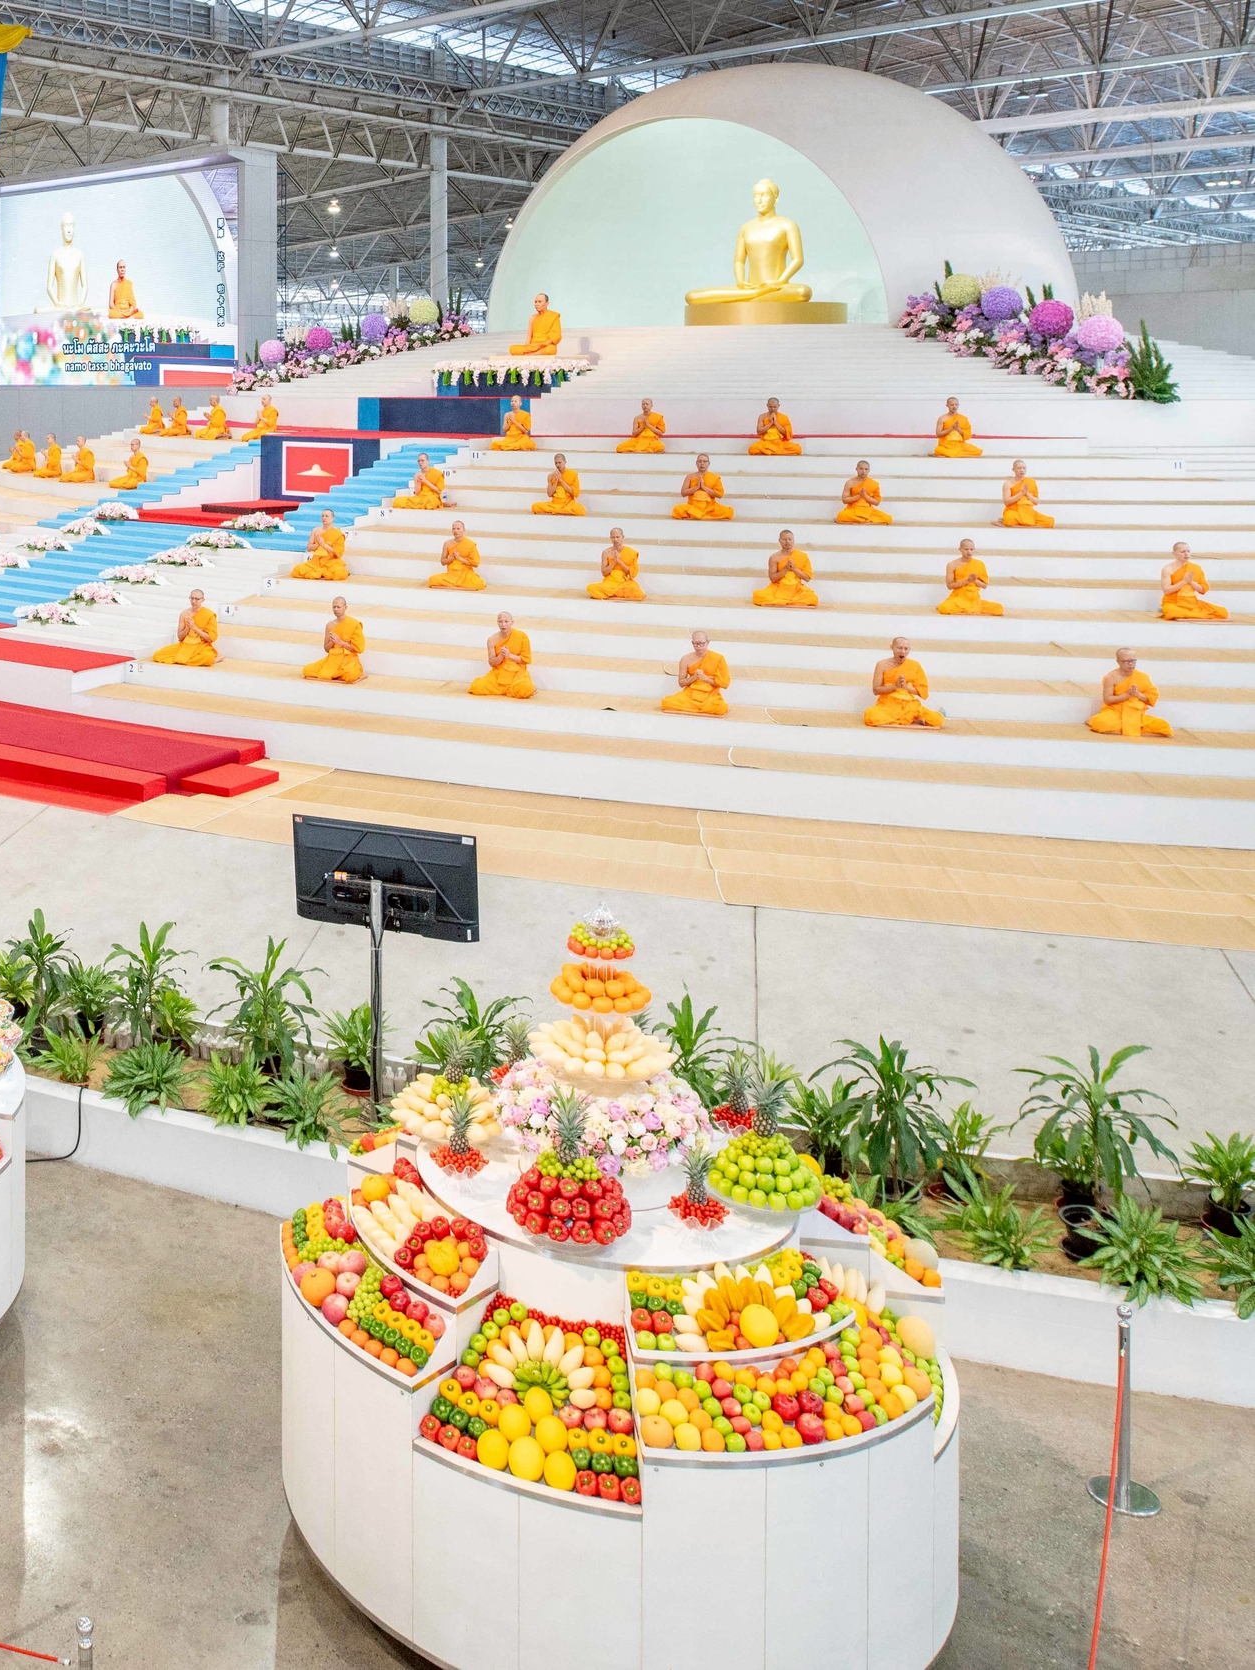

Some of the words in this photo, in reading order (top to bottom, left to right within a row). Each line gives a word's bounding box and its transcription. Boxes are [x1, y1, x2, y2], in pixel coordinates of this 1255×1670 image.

[62, 339, 84, 354] นะโม
[86, 338, 110, 354] ตัสสะ
[111, 337, 156, 353] ภะคะวะโต
[65, 362, 87, 371] namo
[88, 361, 108, 371] tassa
[110, 360, 152, 372] bhagavato
